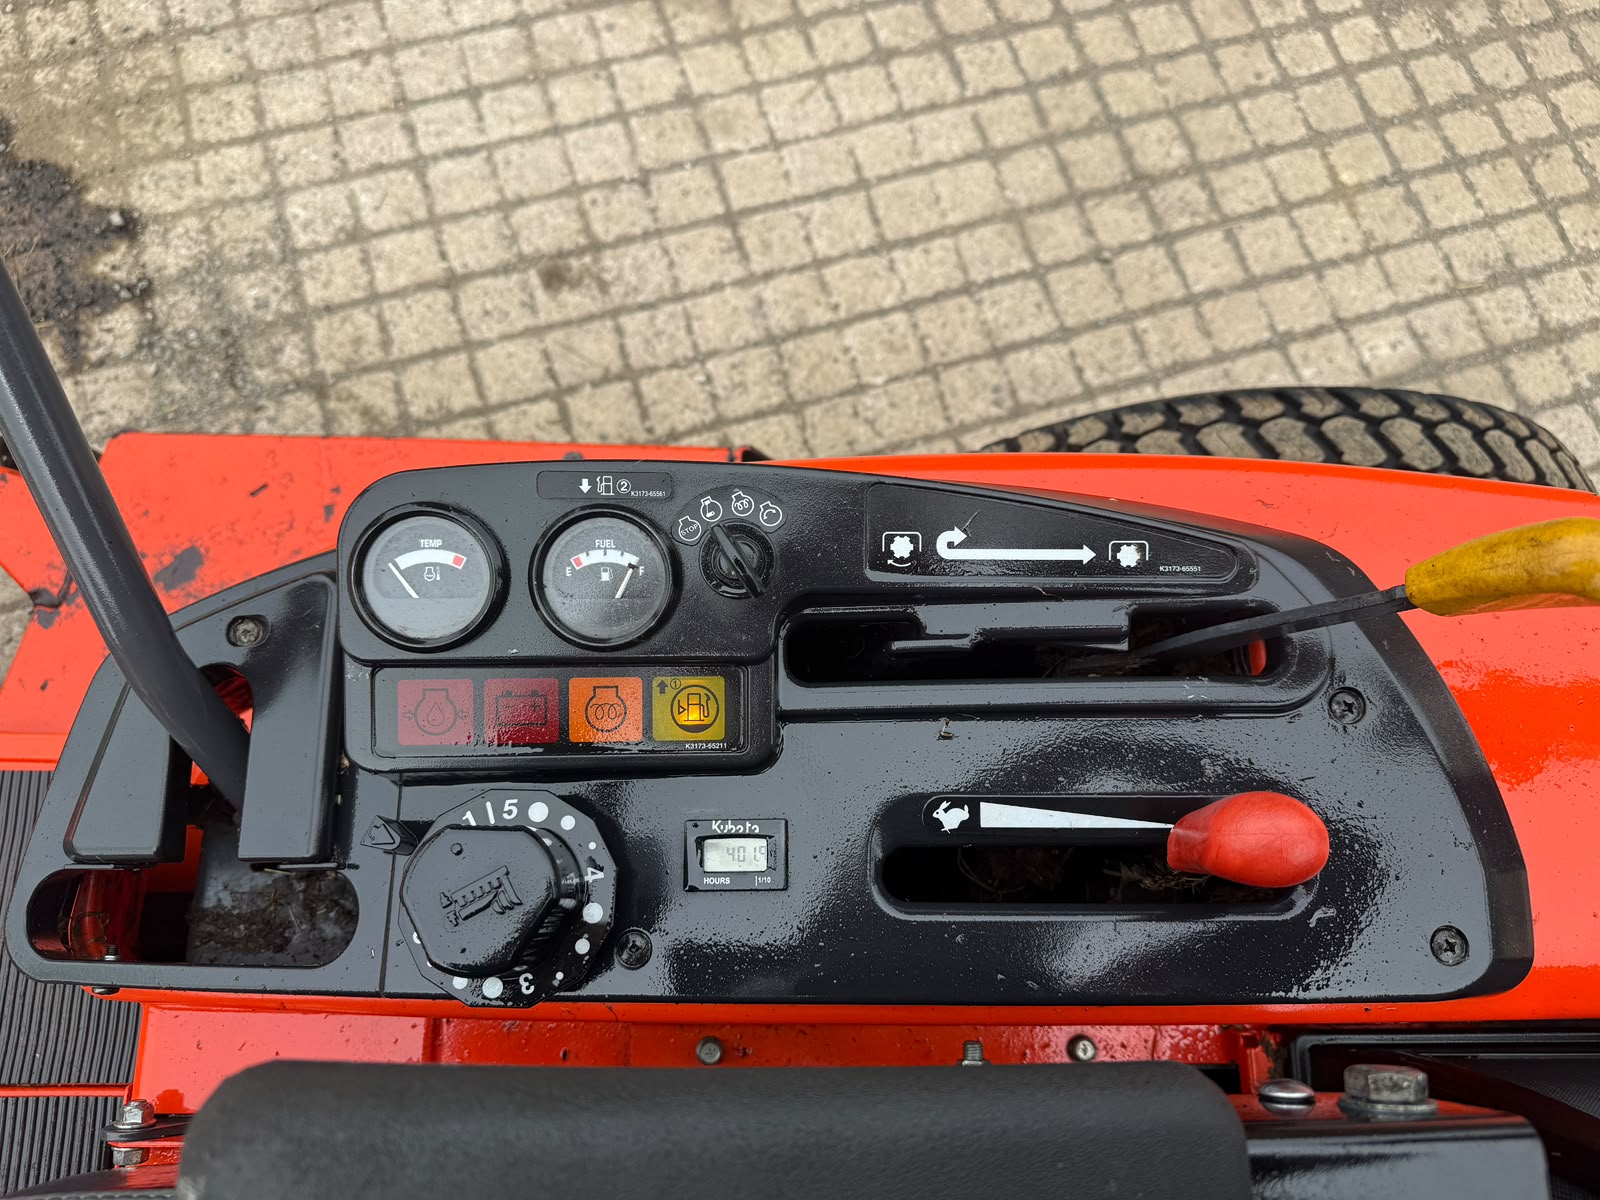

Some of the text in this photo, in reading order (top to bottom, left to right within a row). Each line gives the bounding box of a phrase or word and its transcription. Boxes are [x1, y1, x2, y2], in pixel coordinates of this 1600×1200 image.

[680, 523, 699, 536] STOP
[419, 538, 443, 548] TEMP
[595, 539, 617, 549] FUEL
[565, 567, 572, 577] E
[639, 567, 645, 576] F
[502, 799, 519, 820] 5
[712, 820, 760, 833] Kubota
[585, 867, 605, 883] 4
[703, 877, 731, 885] HOURS
[518, 973, 536, 995] 3
